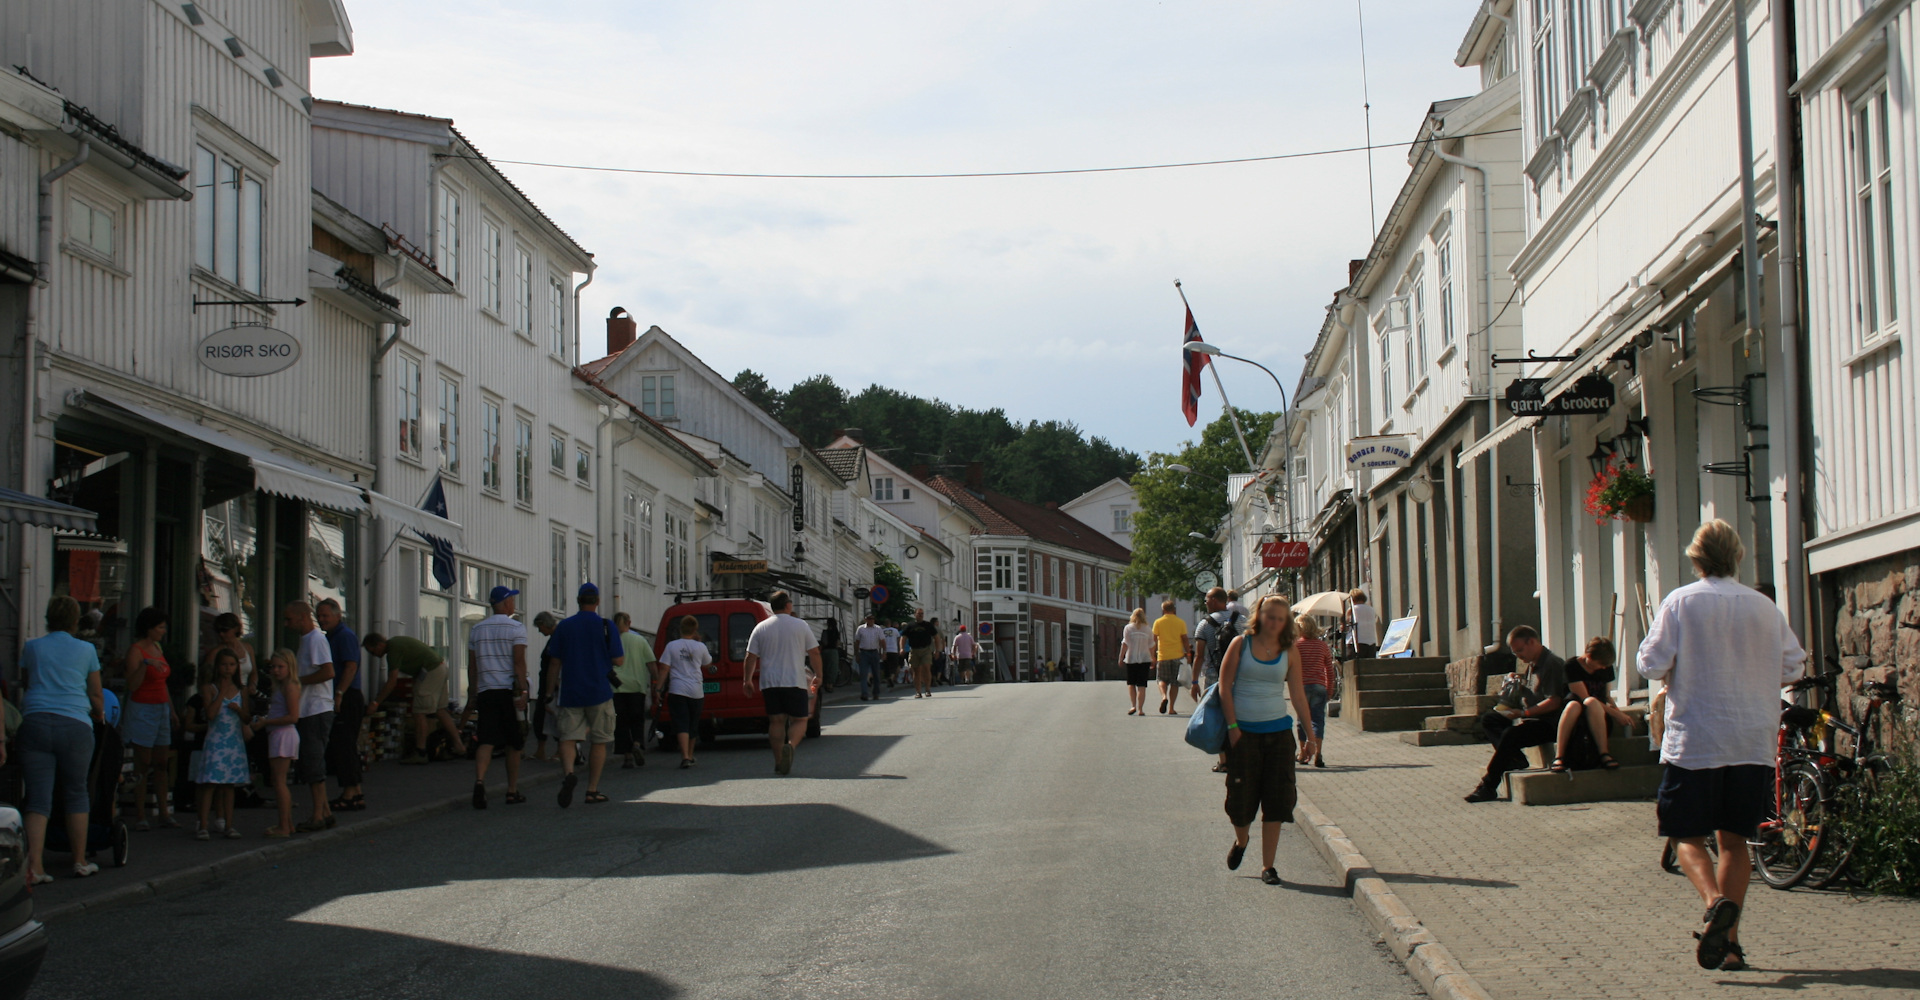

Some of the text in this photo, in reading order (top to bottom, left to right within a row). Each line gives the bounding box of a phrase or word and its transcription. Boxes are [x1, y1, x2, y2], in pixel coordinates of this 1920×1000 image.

[206, 344, 291, 358] RISØR SKO
[1510, 399, 1543, 414] garn
[1561, 397, 1610, 410] broderi
[1348, 446, 1376, 463] BARBER
[794, 468, 802, 507] HOTEL
